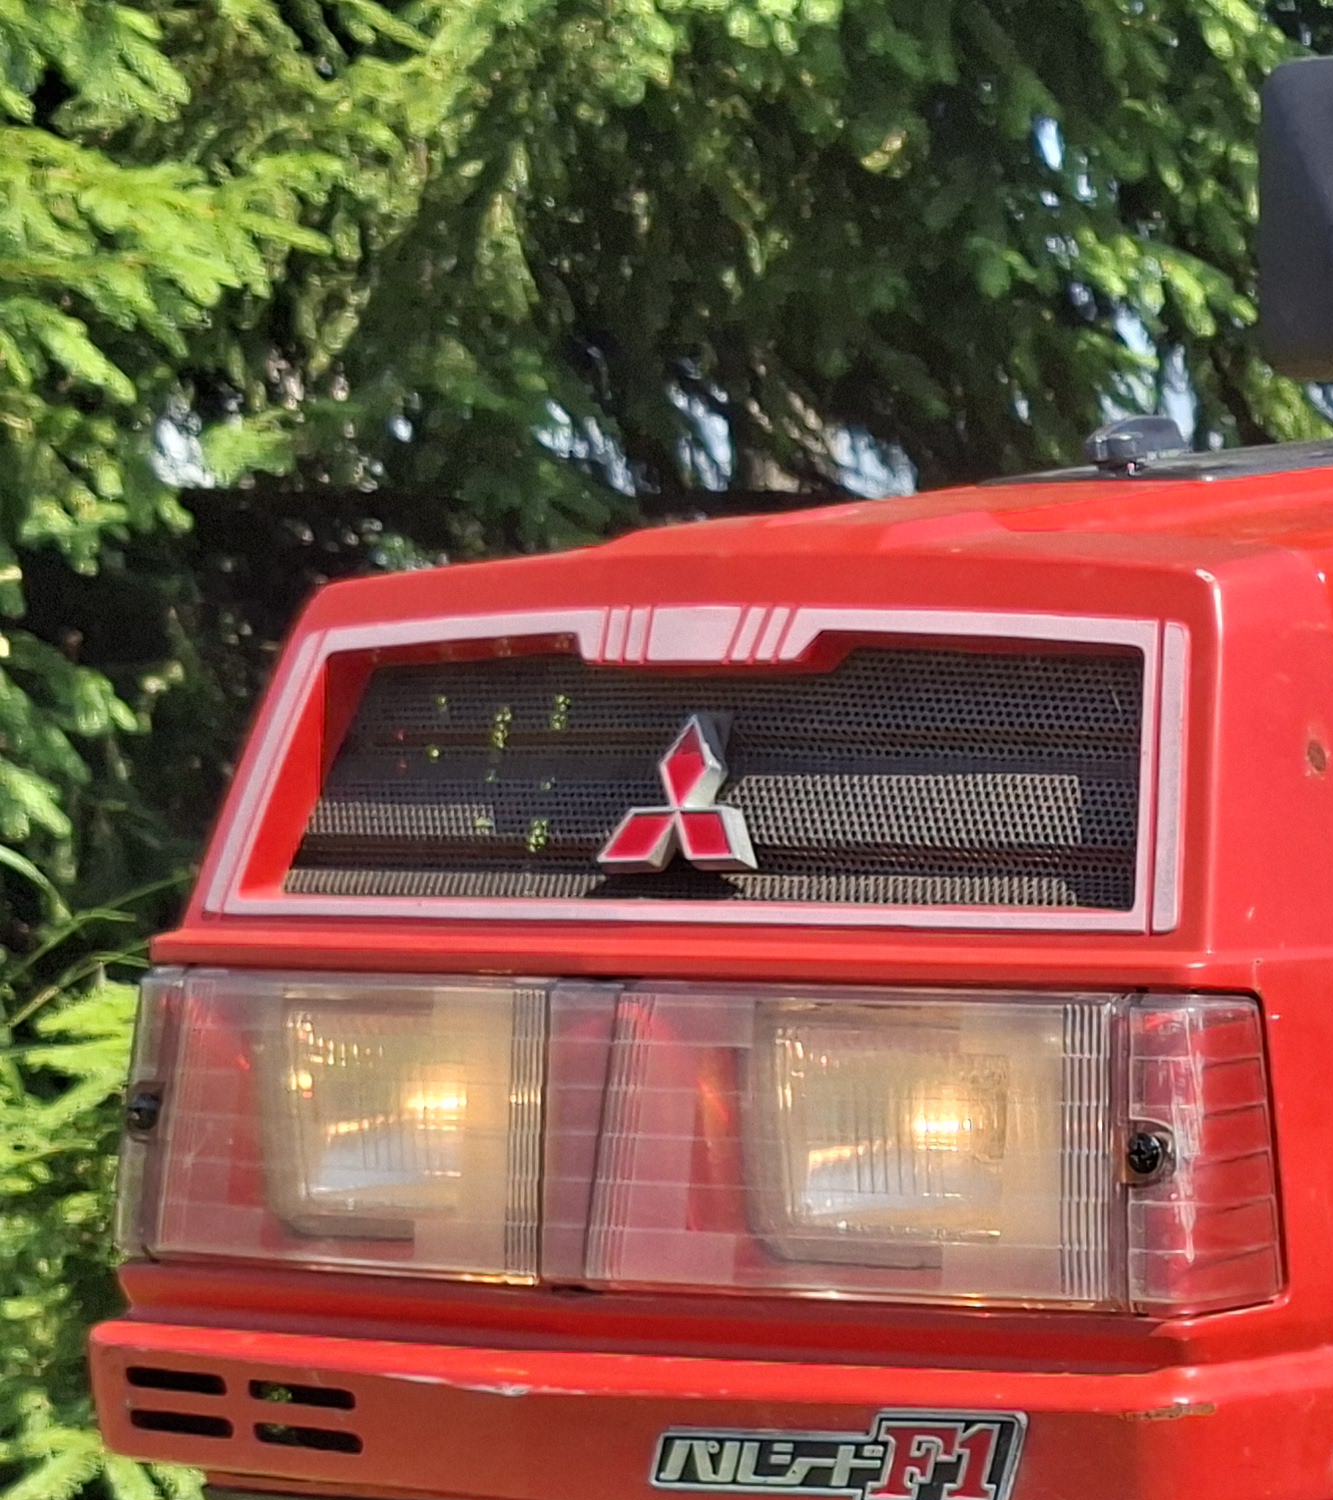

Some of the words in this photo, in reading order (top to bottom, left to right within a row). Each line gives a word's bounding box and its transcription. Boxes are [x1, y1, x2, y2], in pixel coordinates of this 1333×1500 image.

[659, 1438, 884, 1488] パルシード
